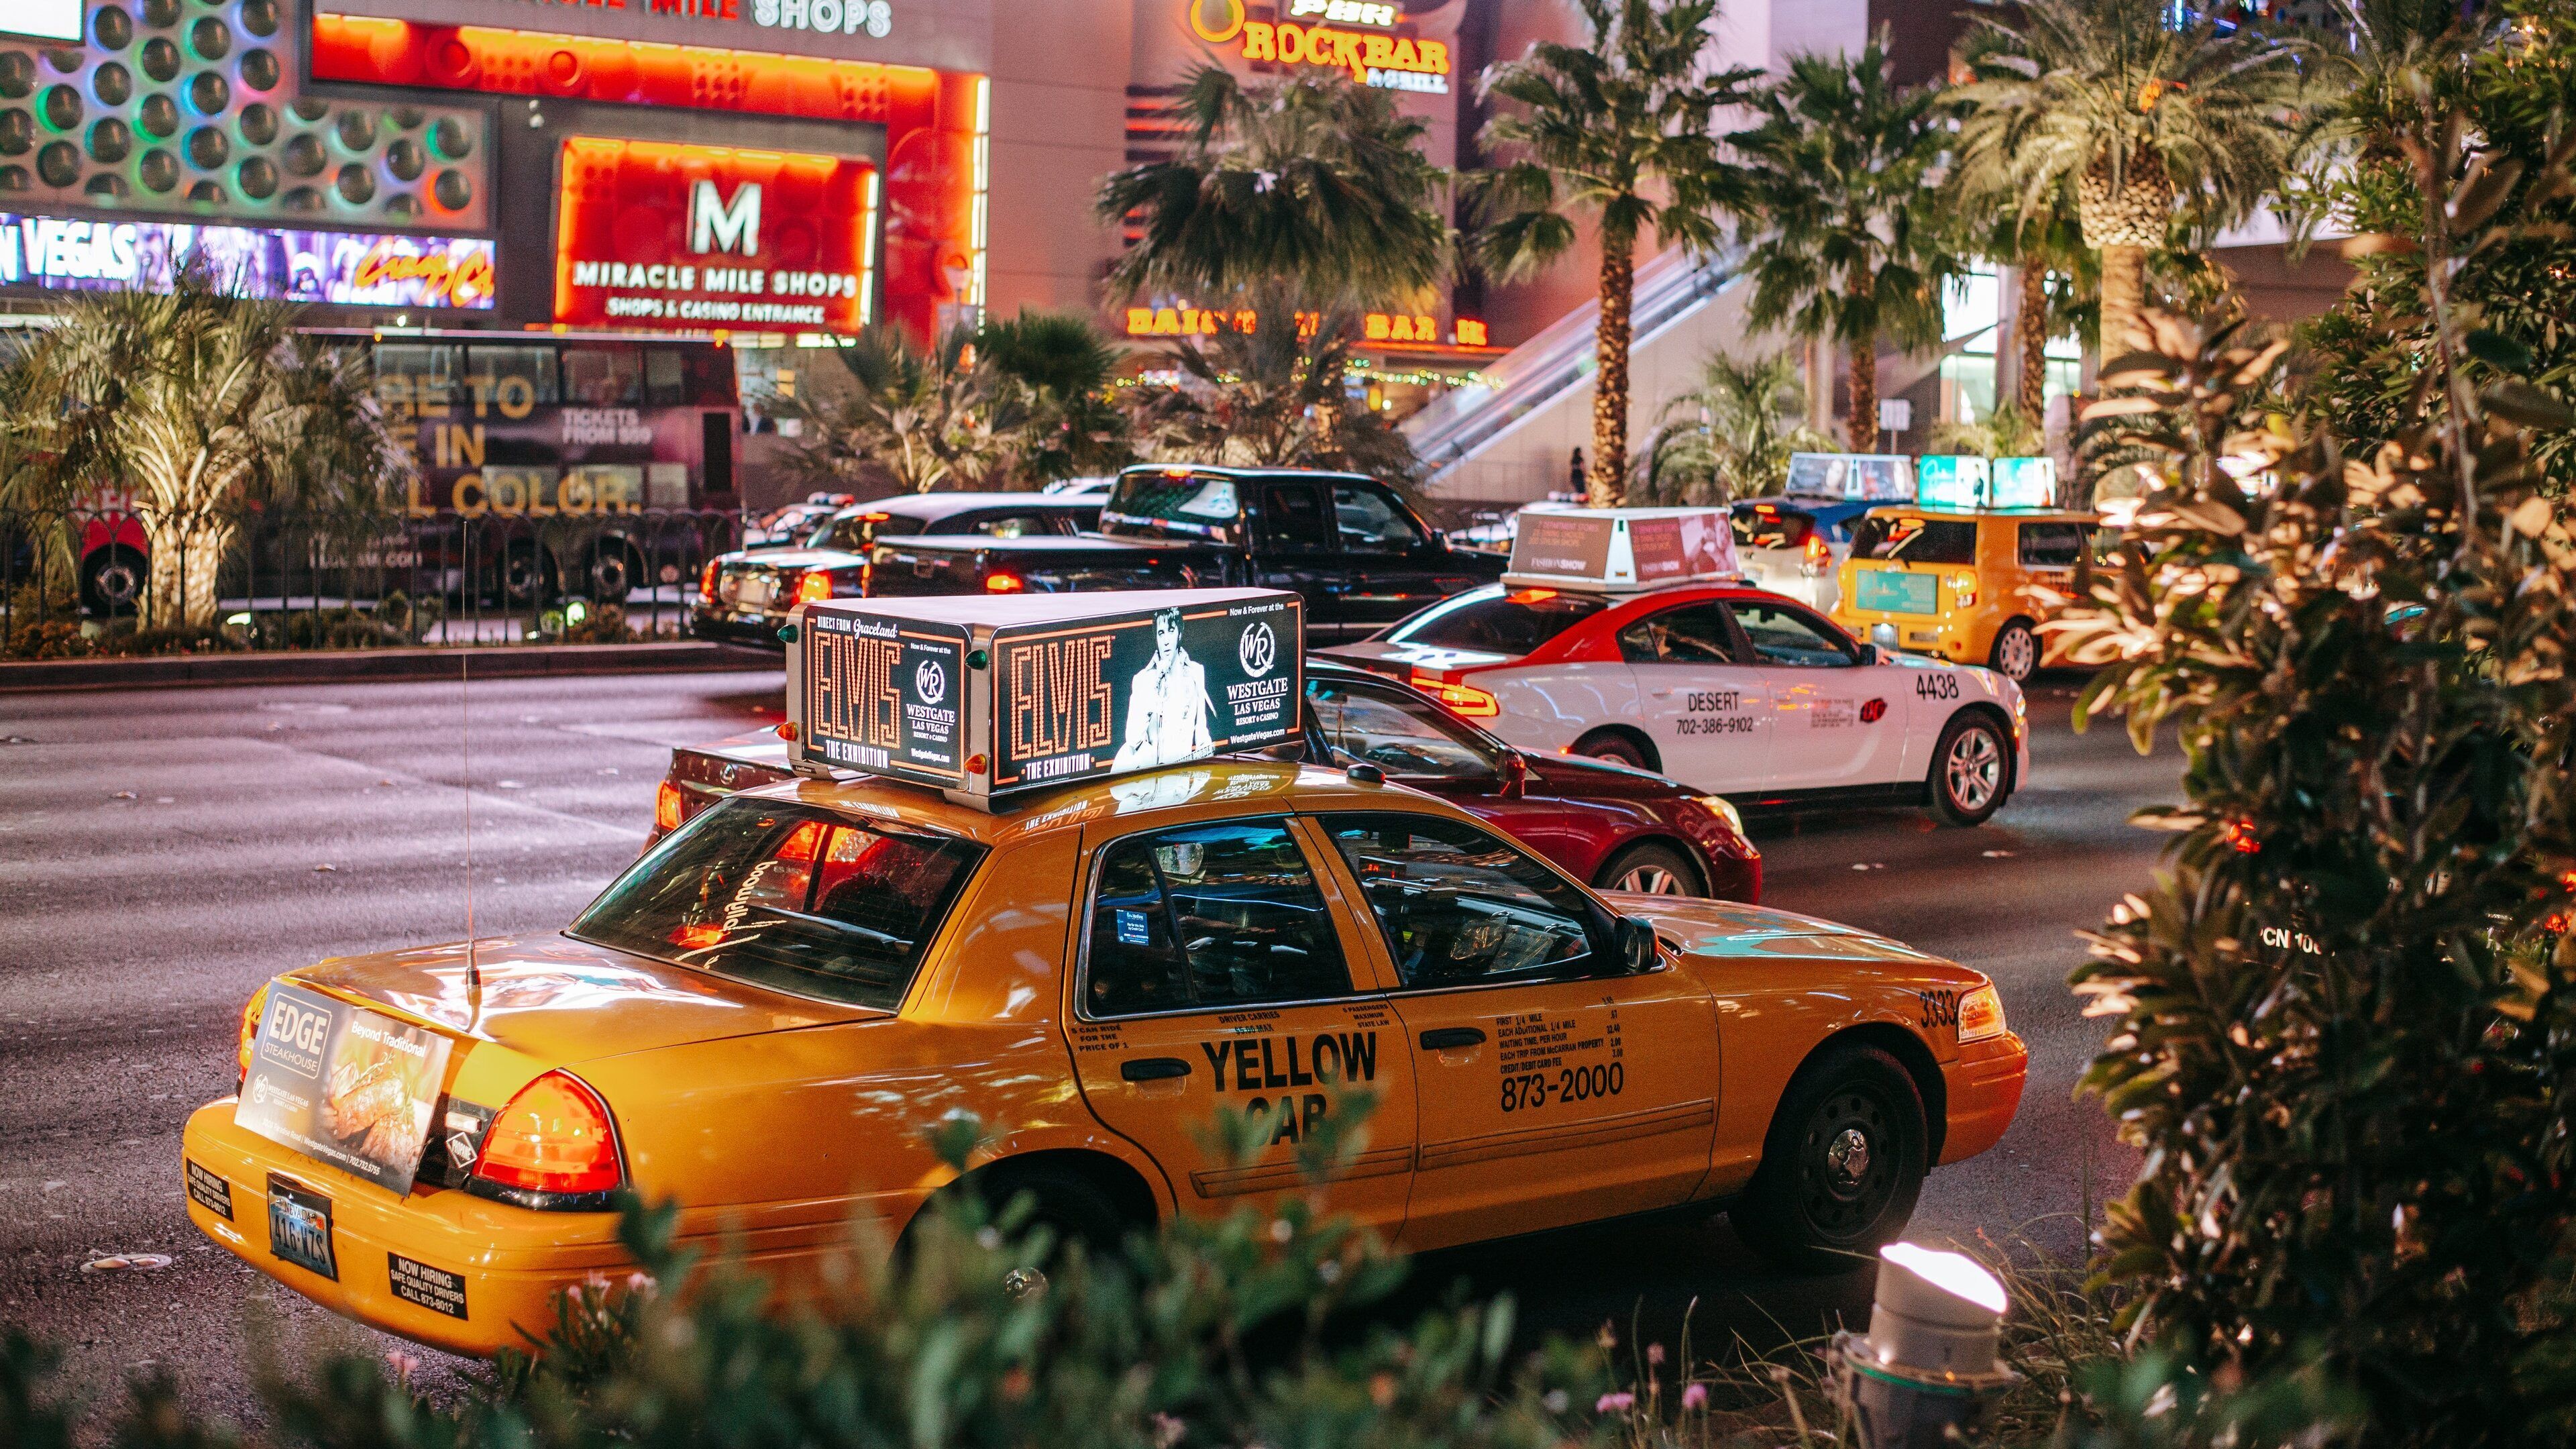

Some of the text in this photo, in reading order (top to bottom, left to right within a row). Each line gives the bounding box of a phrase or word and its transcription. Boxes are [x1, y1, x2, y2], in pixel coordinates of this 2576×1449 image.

[755, 0, 892, 38] SHOPS
[690, 179, 762, 257] M
[21, 218, 136, 281] VEGAS
[573, 260, 857, 299] MIRACLE MILE SHOPS
[607, 297, 663, 317] SHOPS
[680, 301, 740, 321] CASINO
[741, 305, 825, 323] ENTRANCE
[1366, 314, 1436, 341] BAR
[465, 374, 535, 419] TO
[435, 424, 486, 468] IN
[1243, 606, 1247, 614] &
[1248, 606, 1268, 614] Forever
[1275, 602, 1284, 610] the
[818, 616, 896, 639] DIRECT FROM Graceland
[814, 631, 901, 749] ELVIS
[1010, 635, 1111, 761] ELVIS
[1226, 678, 1288, 700] WESTGATE
[1917, 674, 1959, 700] 4438
[906, 703, 955, 723] WESTGATE
[1234, 698, 1281, 716] LAS VEGAS
[1688, 692, 1739, 712] DESERT
[912, 720, 949, 735] LAS VEGAS
[1236, 712, 1279, 726] RESORT CASINO
[1676, 716, 1754, 735] 702-386-9102
[1230, 729, 1285, 744] WestgateVegas.com
[826, 739, 888, 769] THE EXHIBITION
[1026, 753, 1090, 780] THE EXHIBITION
[1218, 1011, 1280, 1024] DRIVER CARRIES
[1348, 1004, 1389, 1012] PASSENGERS
[1354, 1012, 1385, 1020] MAXIMUM
[1919, 989, 1957, 1028] 3333
[269, 1001, 327, 1055] EDGE
[1101, 1024, 1122, 1032] RIDE
[1257, 1024, 1274, 1032] MAX
[1357, 1020, 1375, 1028] STATE
[1496, 1016, 1511, 1026] FIRST
[1515, 1016, 1525, 1027] 1/4
[1529, 1013, 1542, 1022] MILE
[1498, 1028, 1513, 1037] EACH
[1515, 1025, 1548, 1035] ADDITIONAL
[1562, 1020, 1576, 1029] MILE
[351, 1020, 427, 1057] Beyond Traditional
[1079, 1044, 1106, 1052] PRICE
[1499, 1038, 1522, 1049] WAITING
[1540, 1034, 1550, 1044] PER
[1552, 1032, 1567, 1042] HOUR
[1500, 1051, 1515, 1061] EACH
[1517, 1049, 1529, 1059] TRIP
[1530, 1046, 1546, 1057] FROM
[1547, 1042, 1576, 1055] McCARRAN
[1578, 1038, 1604, 1050] PROPERTY
[265, 1042, 317, 1071] STEAKHOUSE
[1201, 1031, 1377, 1092] YELLOW
[1500, 1060, 1536, 1074] CREDIT/DEBIT
[1537, 1058, 1551, 1068] CARD
[1552, 1057, 1562, 1067] FEE
[1501, 1061, 1623, 1112] 873-2000
[295, 1095, 309, 1107] VEGAS
[191, 1163, 223, 1193] NOW HIRING
[188, 1173, 231, 1207] SAFE QUALITY DRIVERS
[193, 1188, 205, 1203] CALL
[284, 1203, 311, 1223] NEVADA
[398, 1258, 452, 1289] NOW HIRING
[390, 1269, 464, 1304] SAFE QUALITY DRIVERS
[401, 1285, 454, 1313] CALL 873-8012
